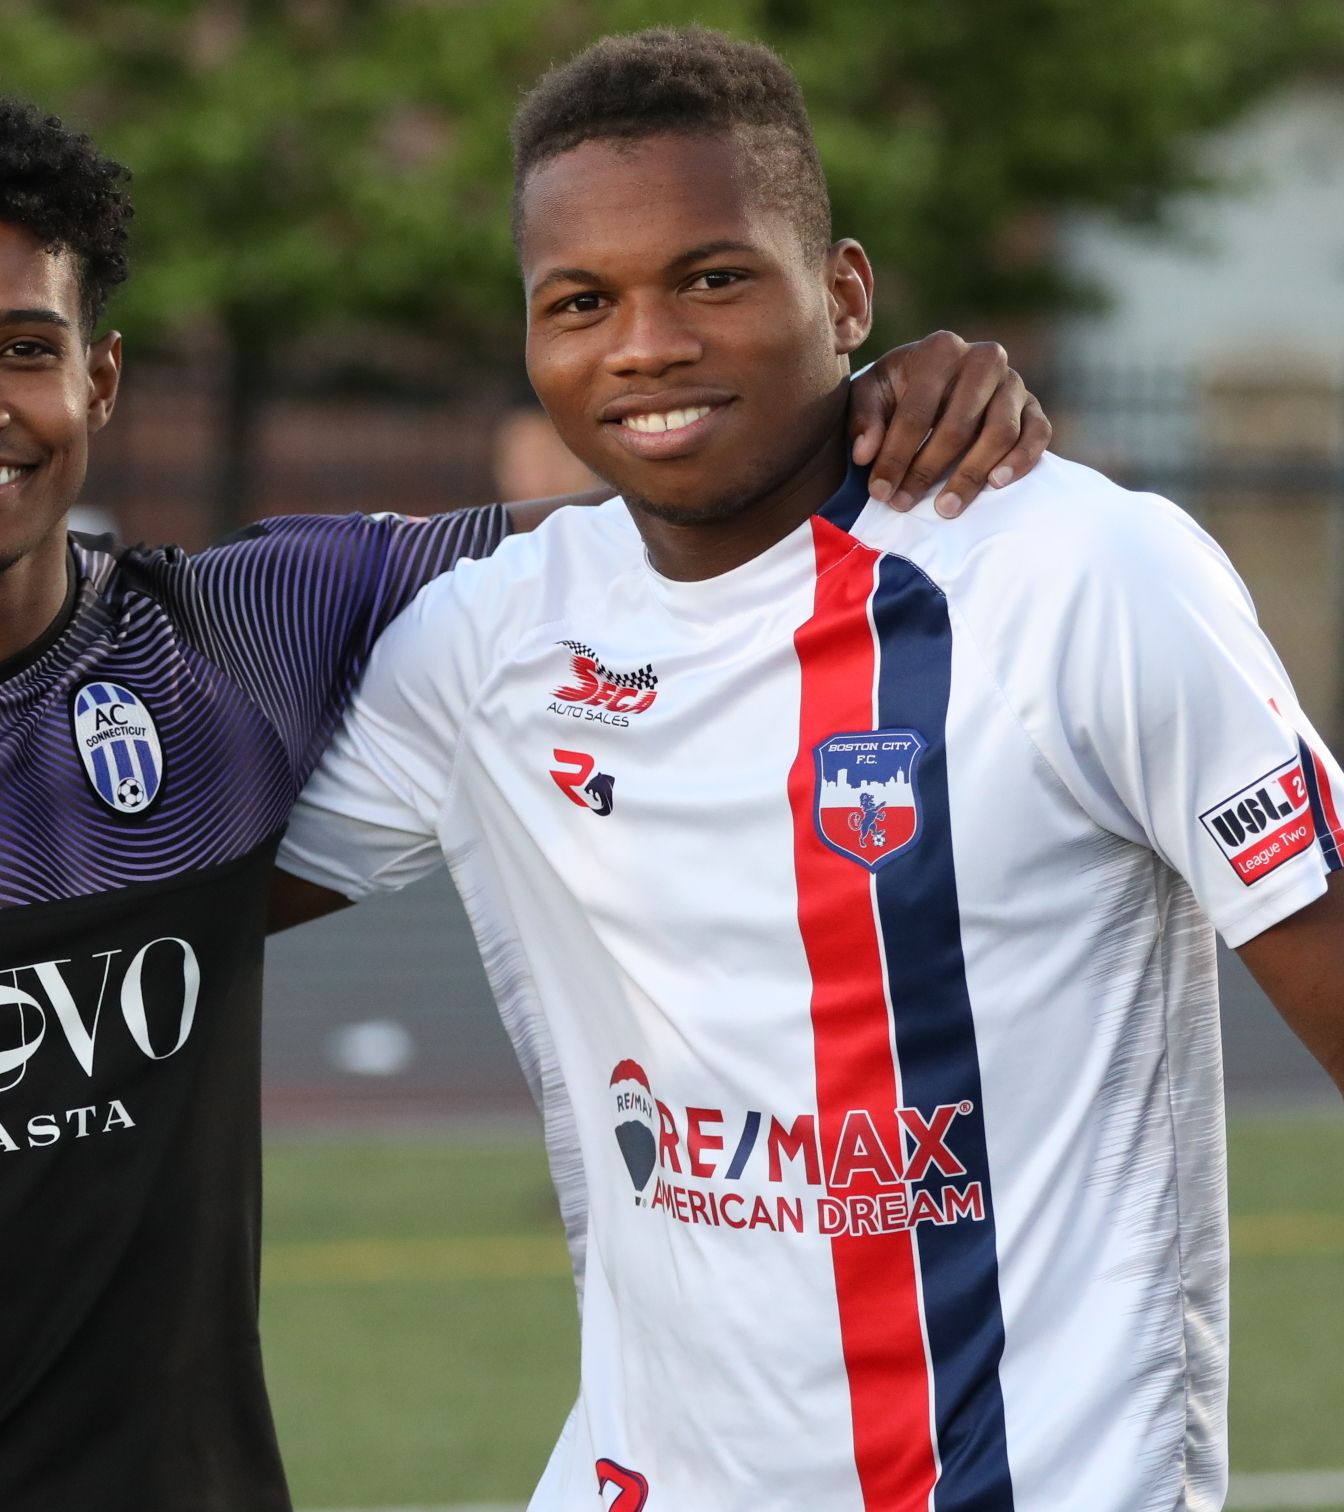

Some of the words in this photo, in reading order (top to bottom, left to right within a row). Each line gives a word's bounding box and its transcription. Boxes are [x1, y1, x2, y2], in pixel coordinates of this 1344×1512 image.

[95, 704, 128, 731] AC
[546, 702, 583, 718] AUTO
[584, 709, 629, 728] SALES
[86, 726, 146, 748] CONNECTICUT
[828, 742, 879, 752] BOSTON
[881, 742, 912, 751] CITY
[856, 755, 878, 765] F.C.
[1211, 787, 1293, 847] USL
[1292, 776, 1305, 798] 2
[1238, 842, 1281, 874] League
[1279, 826, 1306, 847] Two
[616, 1092, 653, 1121] RE/MAX
[652, 1176, 804, 1233] AMERICAN
[817, 1182, 985, 1237] DREAM
